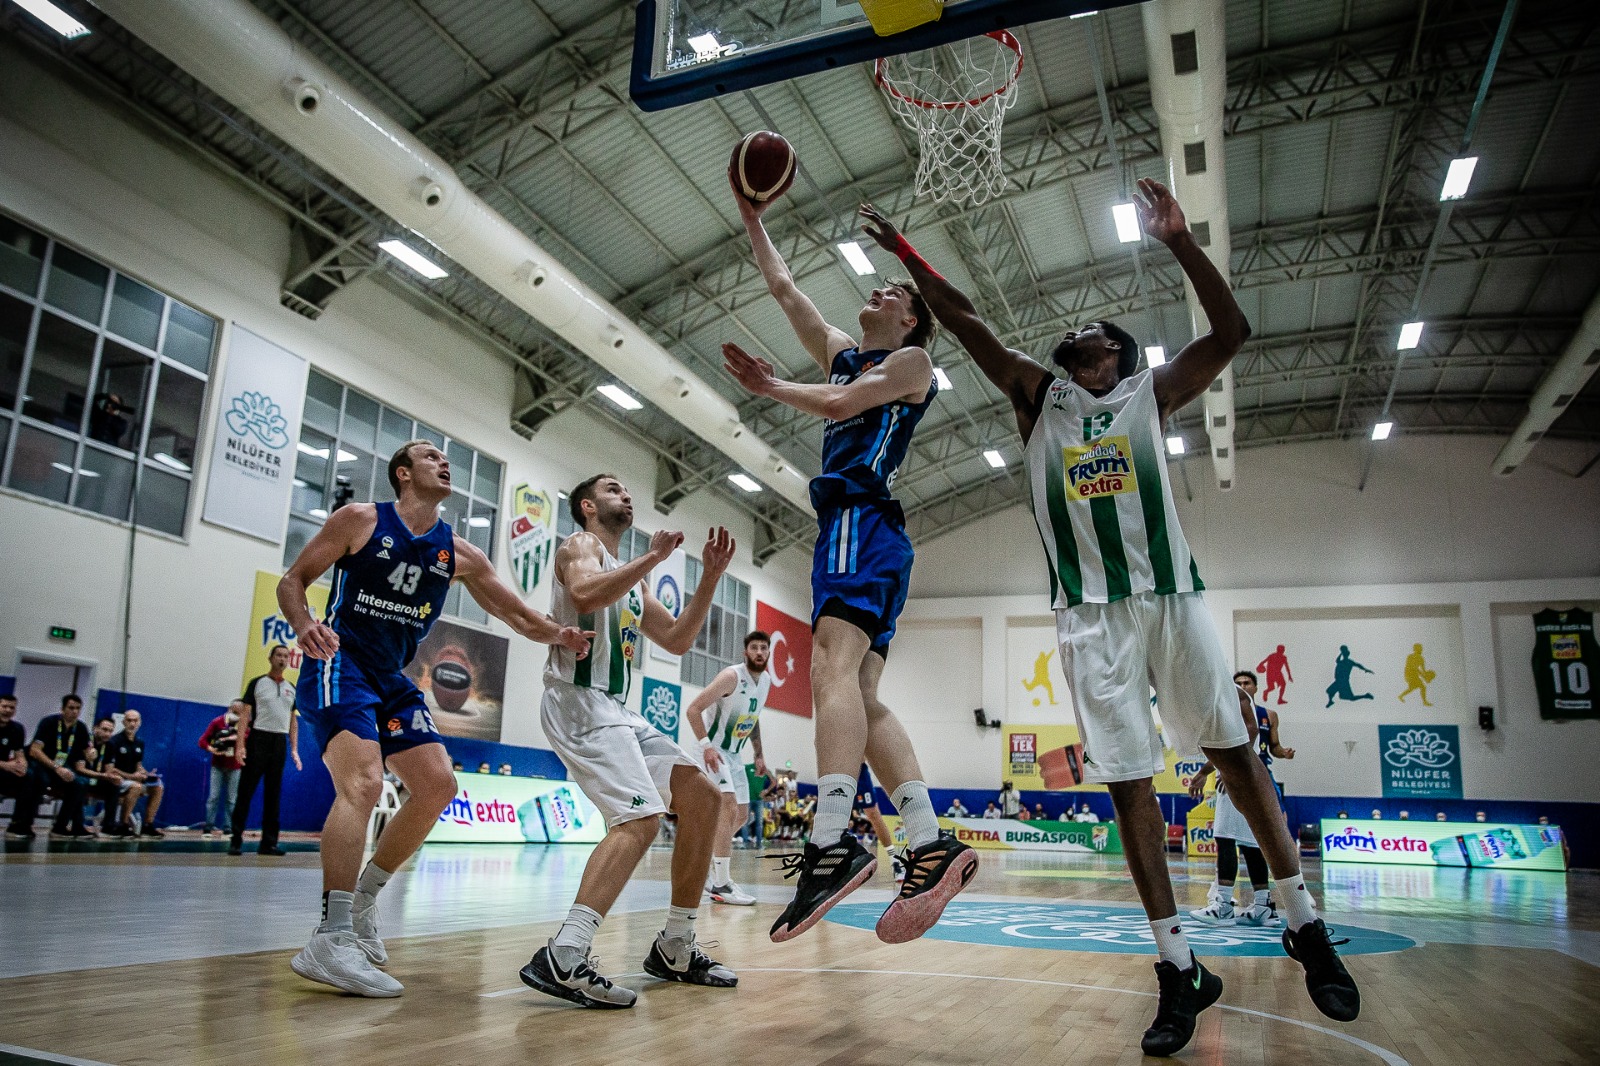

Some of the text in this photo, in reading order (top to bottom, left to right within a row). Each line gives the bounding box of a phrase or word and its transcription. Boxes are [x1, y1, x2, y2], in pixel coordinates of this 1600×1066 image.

[1080, 411, 1114, 442] 13
[226, 437, 281, 468] NİLÜFER
[1079, 477, 1123, 496] extra
[386, 561, 422, 595] 43
[353, 603, 368, 614] Die
[357, 588, 419, 618] interseroh
[263, 615, 297, 647] FRU
[1549, 661, 1591, 694] 10
[1012, 740, 1034, 752] TEK
[1391, 768, 1451, 779] NİLÜFER
[1391, 780, 1451, 788] BELEDİYESİ
[476, 799, 516, 823] extra
[958, 829, 1000, 842] EXTRA
[1005, 831, 1087, 845] BURSASPOR
[1380, 836, 1428, 852] extra
[1196, 842, 1219, 854] ext
